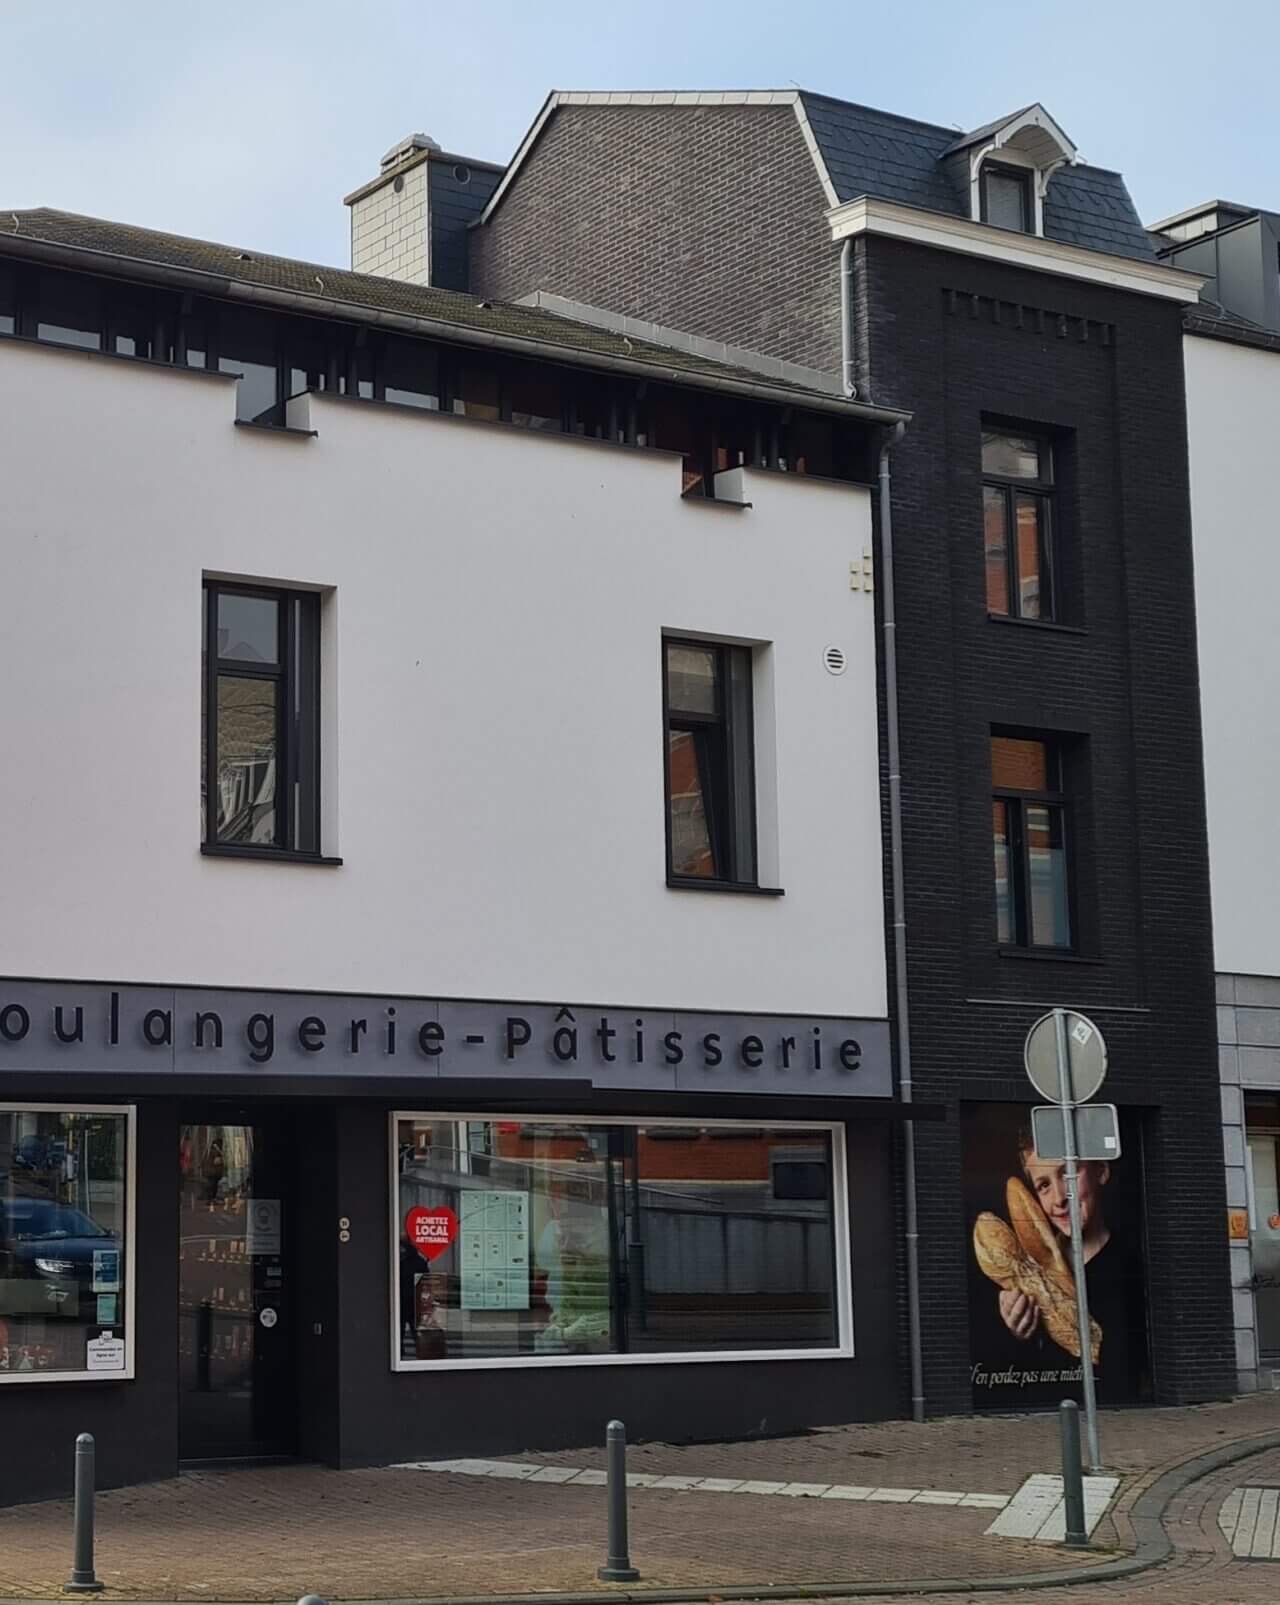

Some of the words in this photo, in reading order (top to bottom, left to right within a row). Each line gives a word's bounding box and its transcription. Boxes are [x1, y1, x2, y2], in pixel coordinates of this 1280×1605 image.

[416, 1216, 449, 1225] ACHETEZ
[415, 1225, 448, 1236] LOCAL
[989, 1364, 1020, 1389] perdez
[1020, 1370, 1038, 1388] pas
[1040, 1370, 1059, 1382] une
